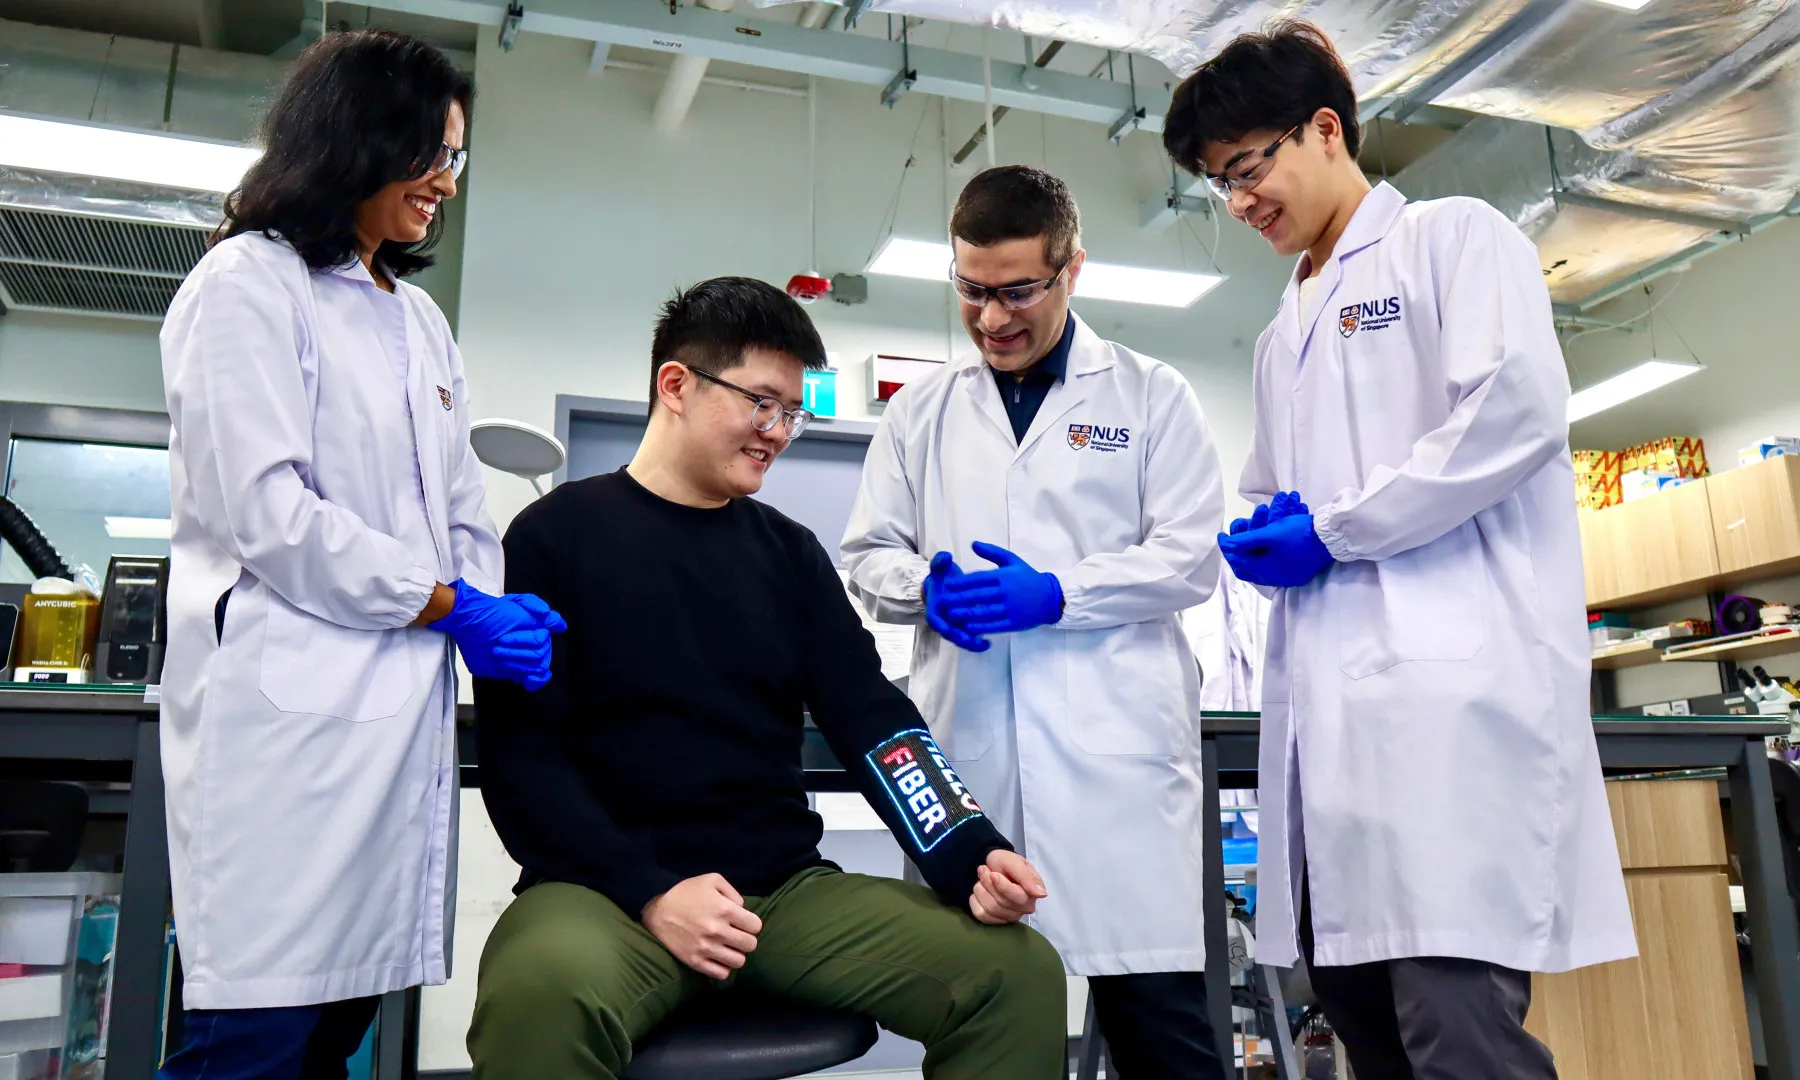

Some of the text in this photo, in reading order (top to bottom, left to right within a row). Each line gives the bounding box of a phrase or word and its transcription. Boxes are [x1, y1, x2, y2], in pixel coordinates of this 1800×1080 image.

[1362, 297, 1400, 318] NUS
[1379, 315, 1401, 323] University
[1093, 425, 1130, 442] NUS
[35, 600, 77, 608] ANYCUBIC
[883, 745, 947, 834] FIBER
